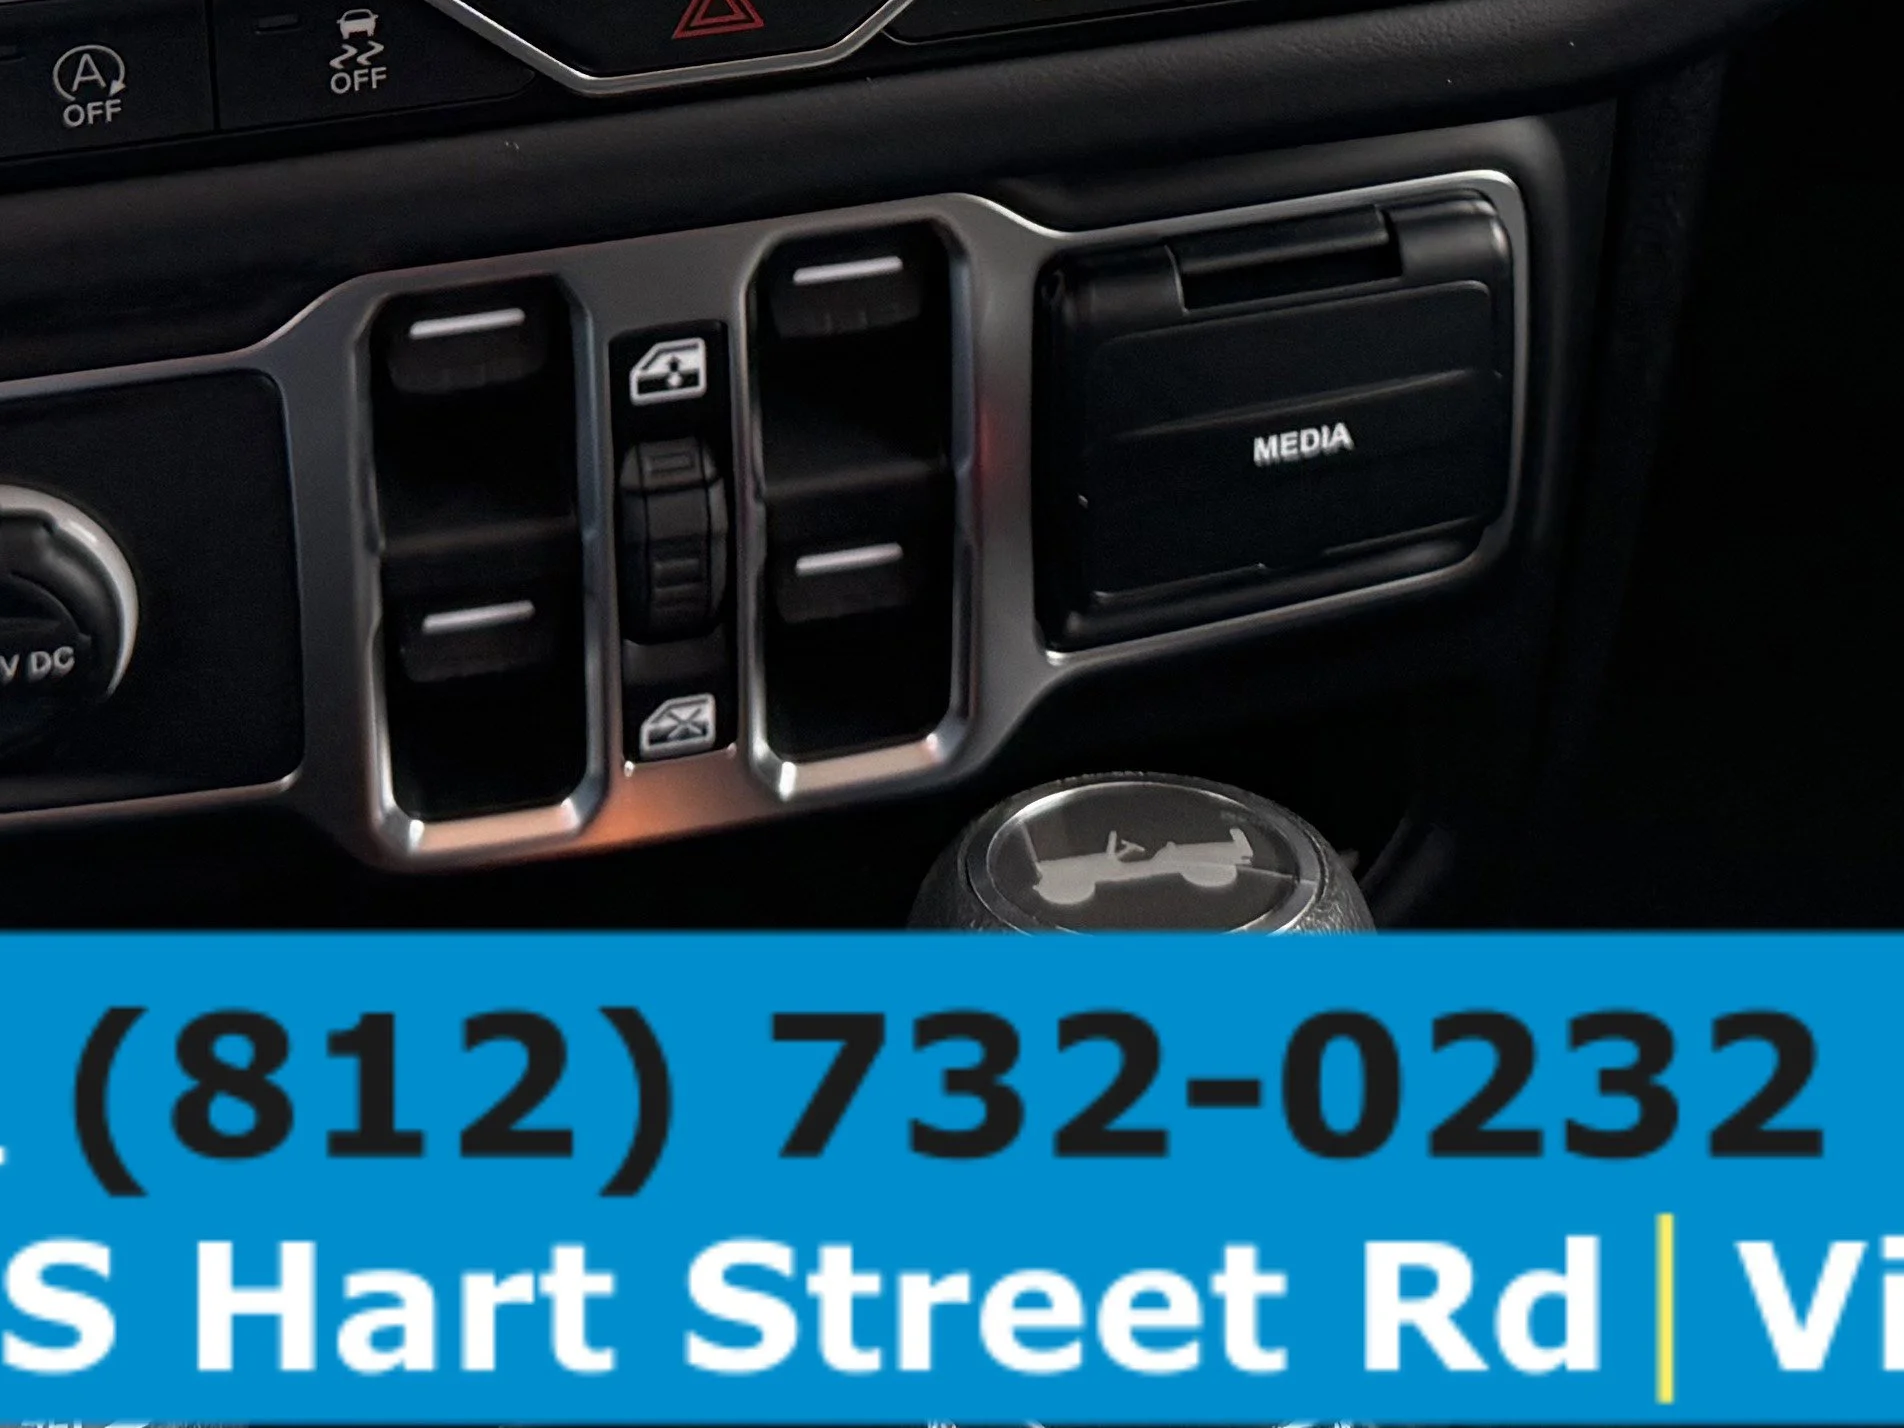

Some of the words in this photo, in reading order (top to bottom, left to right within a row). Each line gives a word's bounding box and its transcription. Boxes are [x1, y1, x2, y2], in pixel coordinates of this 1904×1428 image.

[330, 67, 387, 94] OFF
[63, 99, 122, 127] OFF
[1252, 421, 1355, 466] MEDIA
[30, 648, 76, 678] DC
